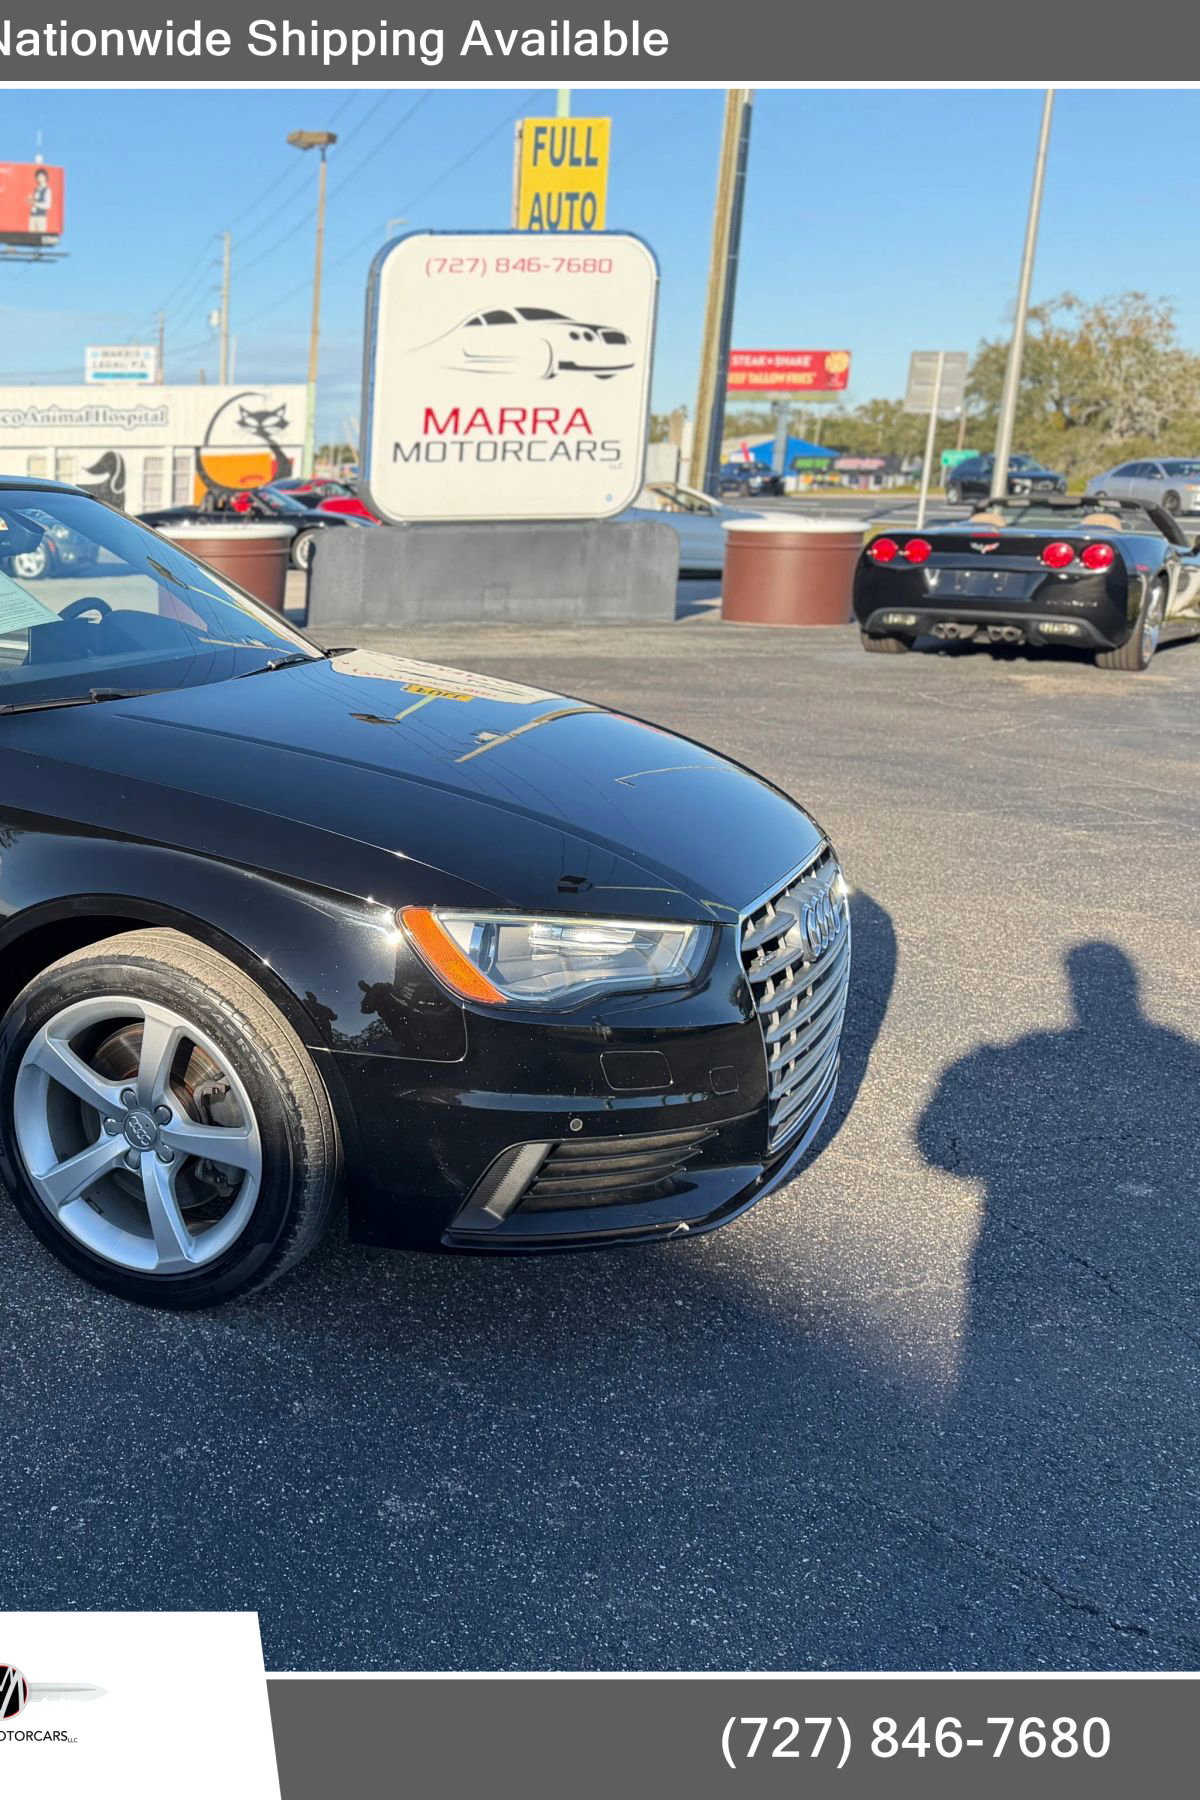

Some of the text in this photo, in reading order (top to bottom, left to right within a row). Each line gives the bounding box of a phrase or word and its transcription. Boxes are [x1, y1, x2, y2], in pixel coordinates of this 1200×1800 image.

[532, 125, 599, 167] FULL
[527, 191, 598, 230] AUTO
[425, 257, 613, 278] (727) 846-7680
[731, 354, 811, 367] STEAK SHAKE
[26, 408, 90, 424] Animal
[94, 408, 166, 427] Hospital
[422, 407, 593, 436] MARRA
[392, 440, 621, 463] MOTORCARS
